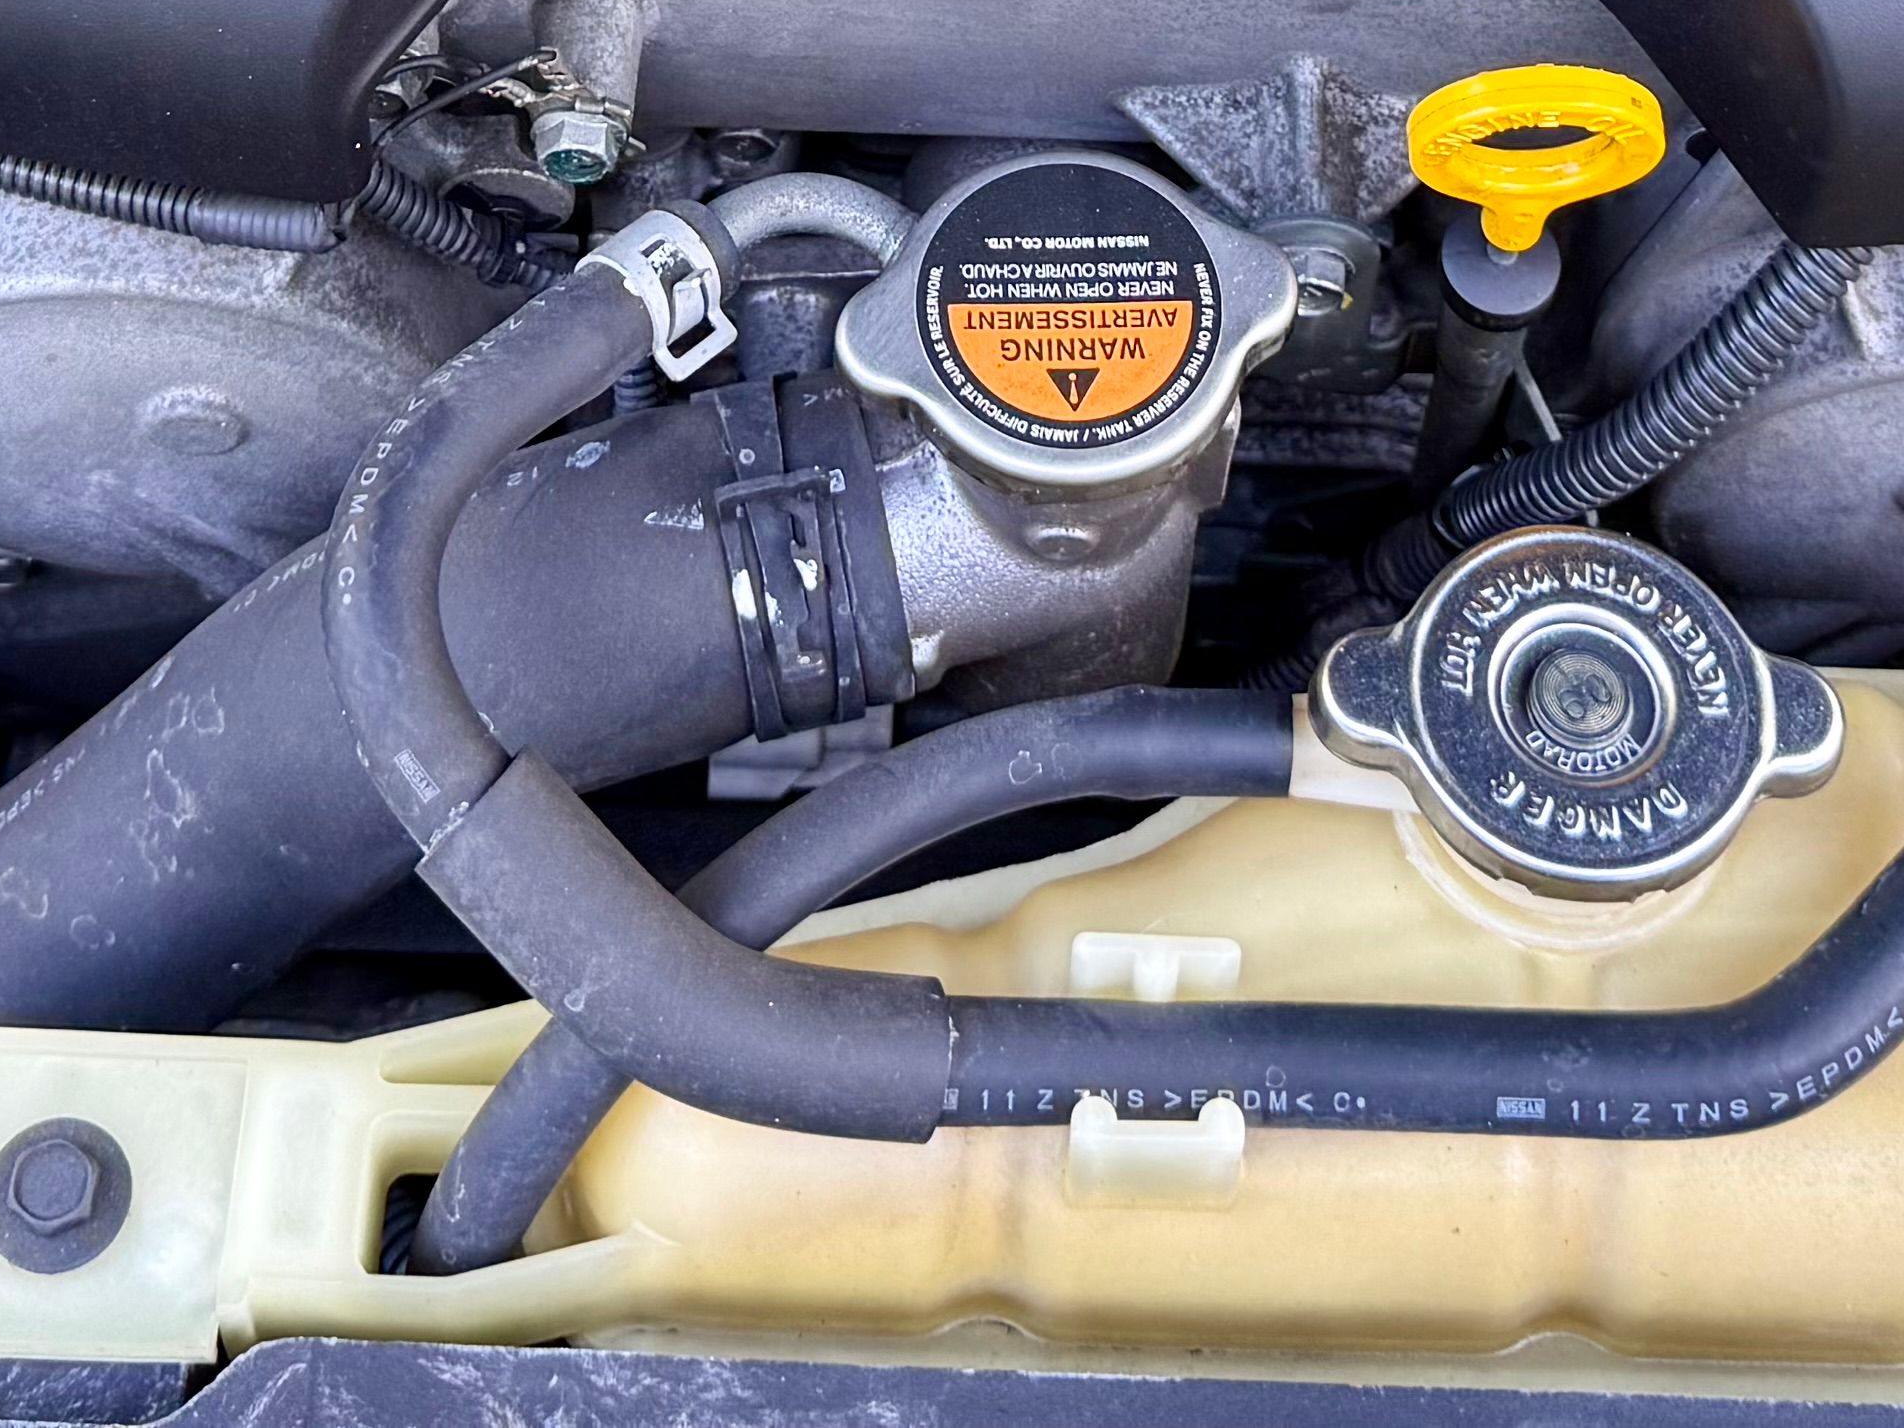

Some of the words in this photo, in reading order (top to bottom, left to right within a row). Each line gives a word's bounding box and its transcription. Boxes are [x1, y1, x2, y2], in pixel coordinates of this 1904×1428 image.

[1424, 111, 1560, 165] ENGINE
[984, 236, 1013, 250] LTD.
[1044, 236, 1095, 249] MOTOR
[1097, 235, 1149, 248] NISSAN
[1036, 262, 1097, 278] OUVRIR
[1097, 261, 1153, 277] JAMAIS
[1154, 260, 1178, 276] NE
[964, 283, 1005, 299] HOT.
[1008, 282, 1063, 298] WHEN
[1068, 281, 1115, 297] OPEN
[1119, 280, 1175, 296] NEVER
[1193, 262, 1214, 306] NEVER
[963, 308, 1178, 331] AVERTISSEMENT
[1200, 306, 1214, 330] FIX
[934, 339, 952, 358] LE
[1000, 337, 1146, 362] WARNING
[1197, 330, 1212, 352] ON
[944, 358, 966, 384] SUR
[1184, 351, 1206, 375] THE
[1133, 372, 1191, 428] RESERVER
[1029, 425, 1081, 443] JAMAIS
[1463, 564, 1560, 630] WHEN
[1564, 562, 1661, 613] OPEN
[1440, 631, 1481, 695] HOT
[1660, 604, 1729, 718] NEVER
[1525, 729, 1642, 773] MOTORAD
[1490, 770, 1689, 841] DANGER
[1497, 1097, 1546, 1119] NISSAN
[1671, 1098, 1749, 1123] TNS
